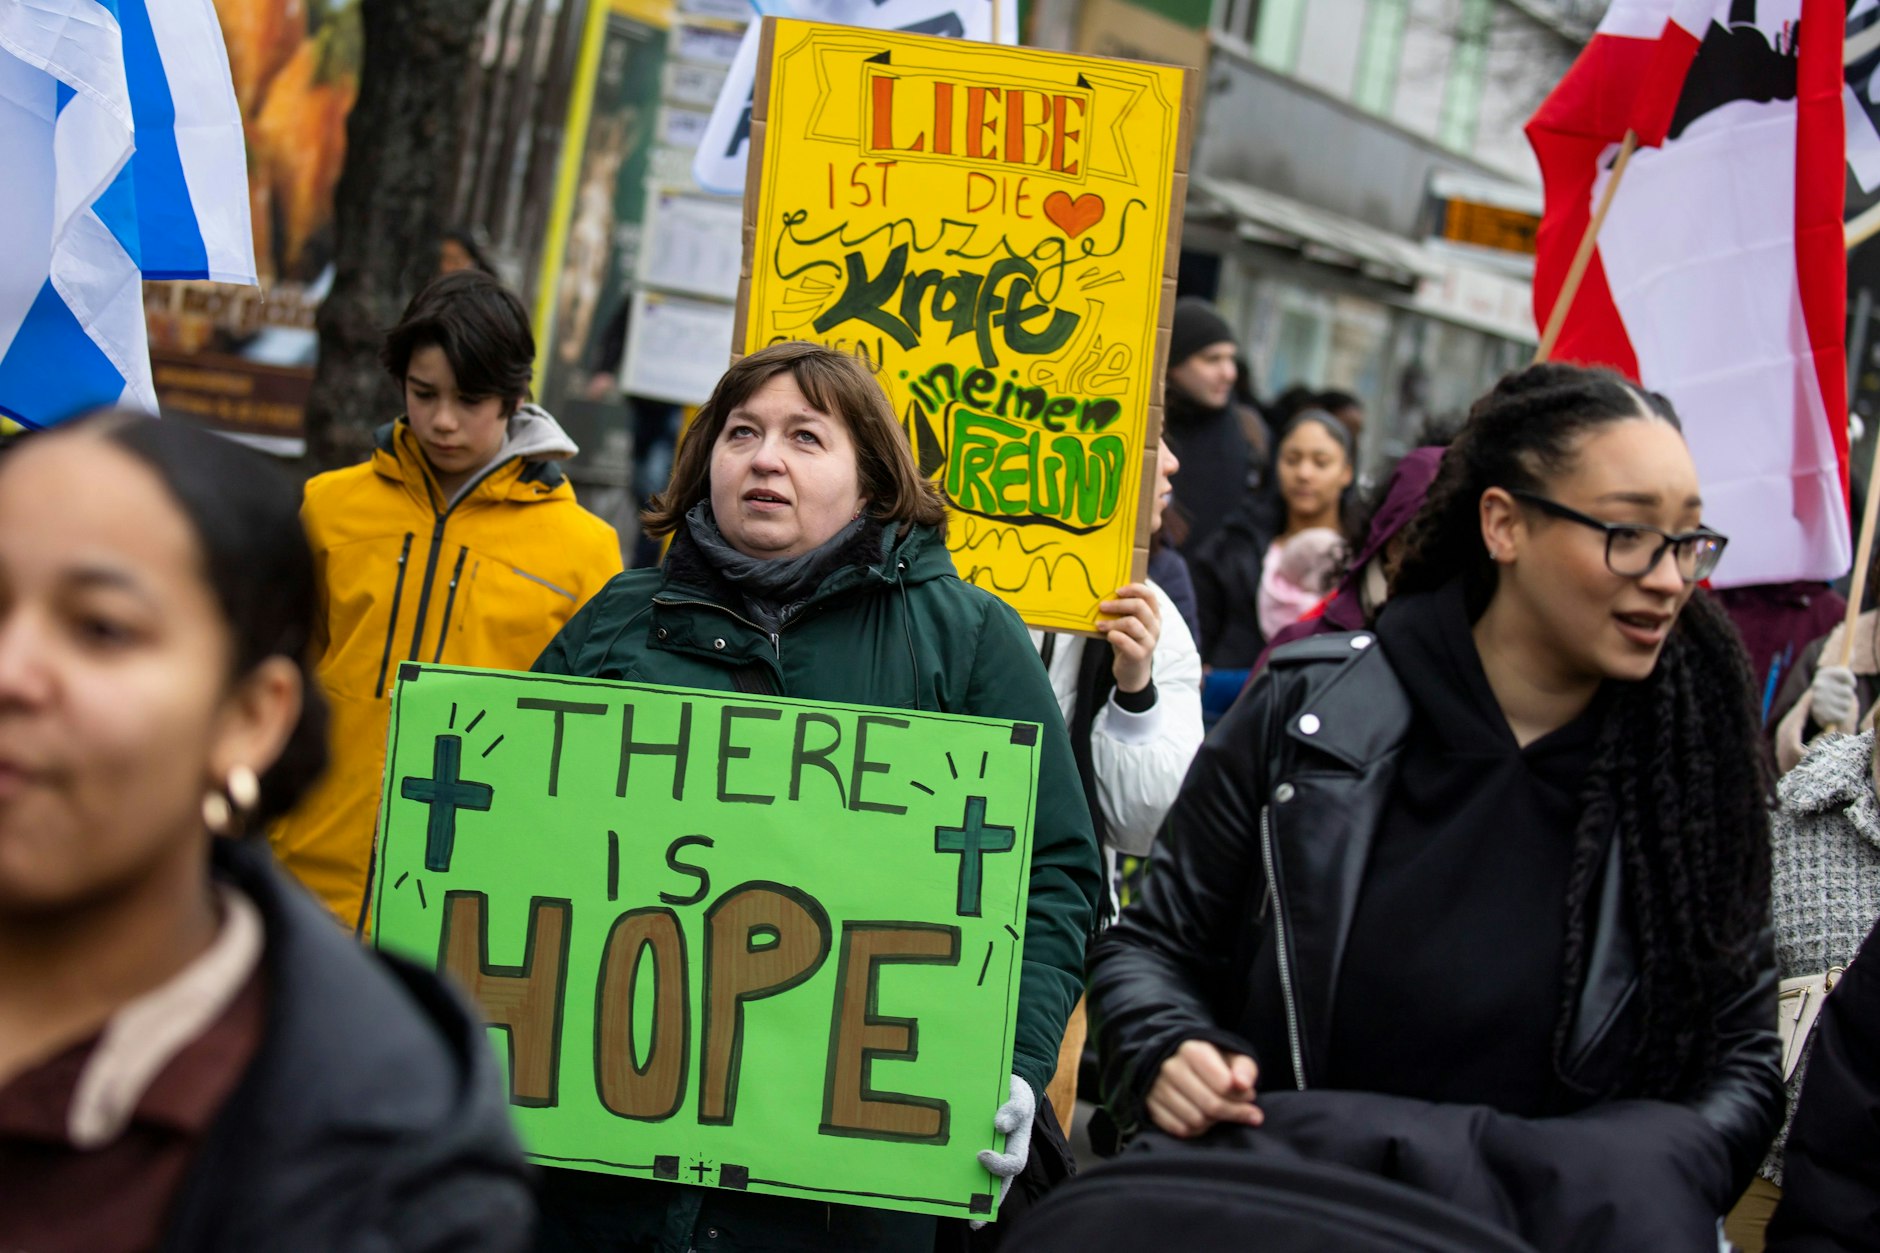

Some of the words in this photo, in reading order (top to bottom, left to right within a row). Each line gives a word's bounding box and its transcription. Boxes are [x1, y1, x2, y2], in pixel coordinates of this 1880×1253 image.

[871, 75, 1087, 175] LIEBE
[828, 160, 898, 210] IST
[967, 171, 1034, 219] DIE
[812, 242, 1081, 368] Kraft
[947, 408, 1125, 525] FREUND
[517, 697, 910, 814] THERE
[608, 830, 714, 905] IS
[437, 880, 961, 1145] HOPE
